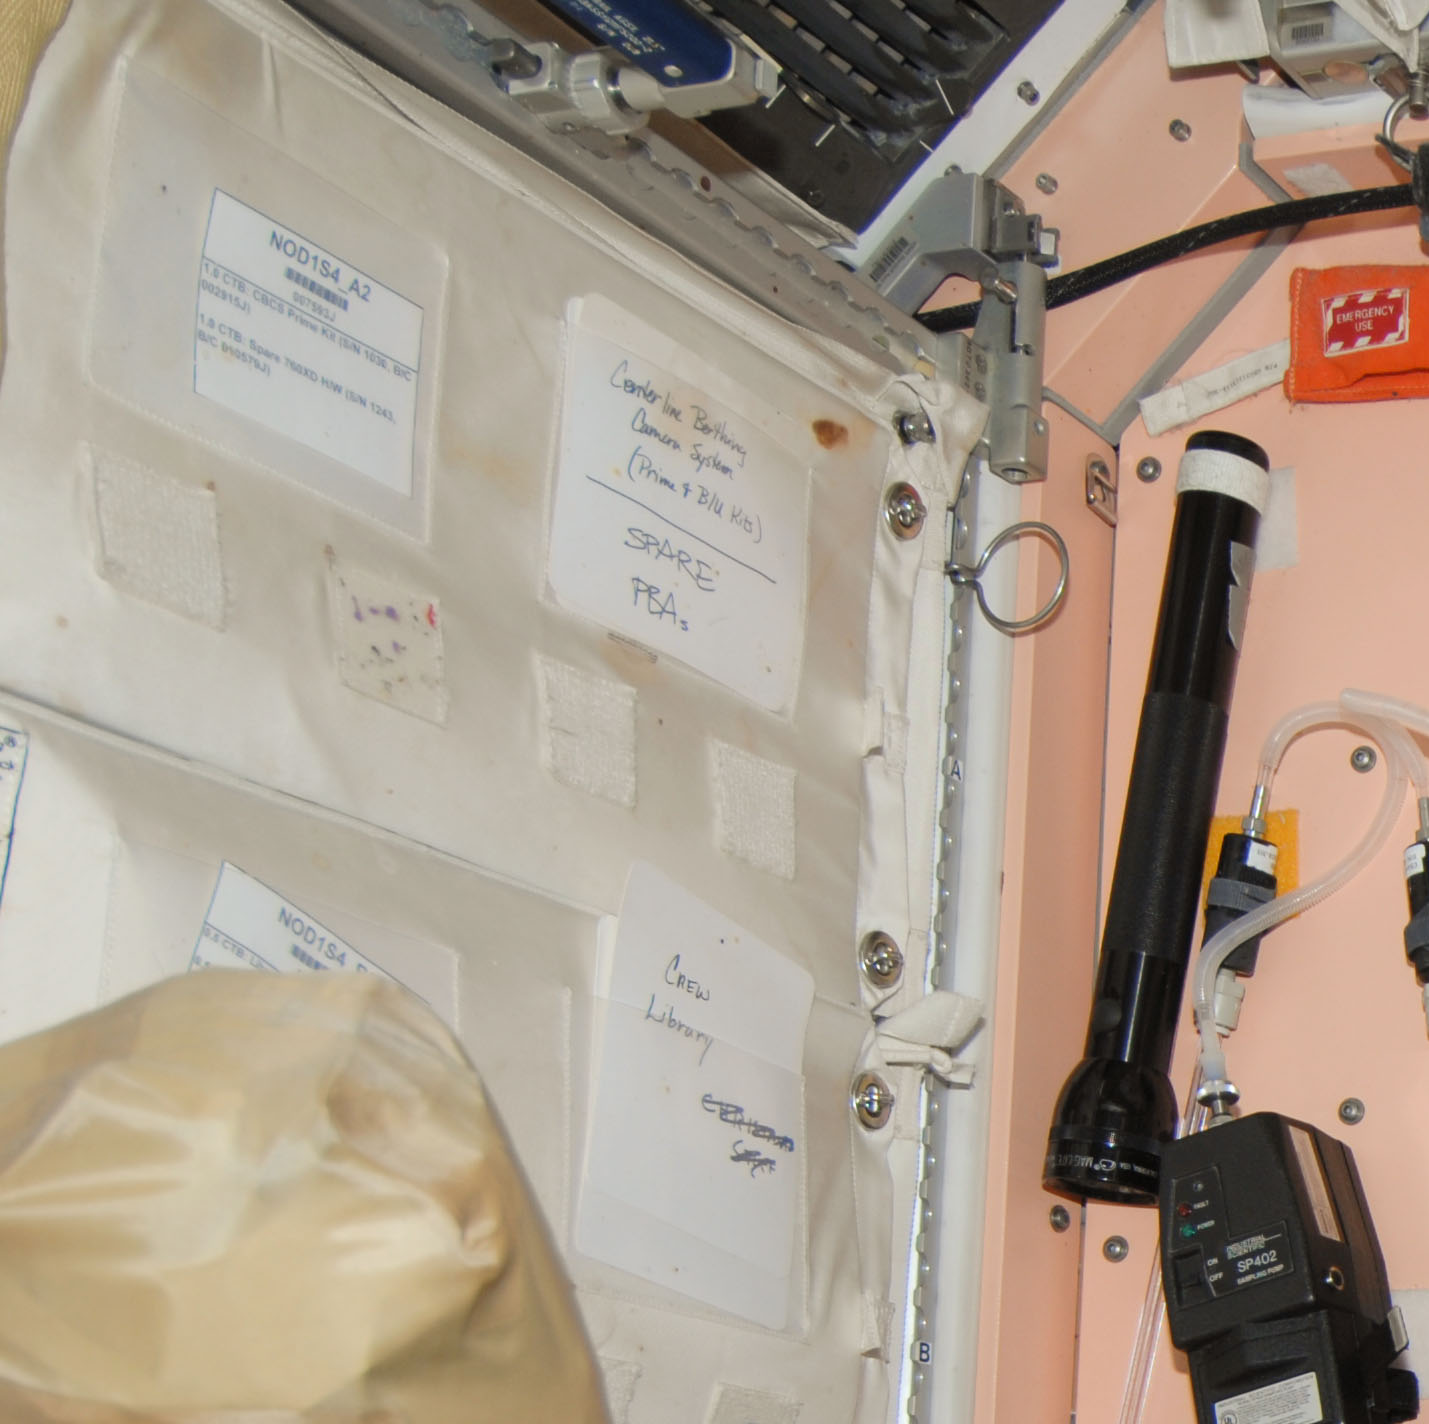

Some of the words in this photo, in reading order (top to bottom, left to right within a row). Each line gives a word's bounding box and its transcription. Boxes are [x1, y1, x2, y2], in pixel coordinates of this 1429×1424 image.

[269, 231, 371, 301] NOD1S4_A2
[1337, 305, 1394, 324] EMERGENCY
[1355, 320, 1373, 332] USE
[632, 407, 681, 453] Camera
[690, 444, 733, 480] System
[691, 405, 746, 467] Berthing
[624, 528, 715, 592] SPARE
[645, 994, 714, 1066] Library
[1208, 1258, 1218, 1266] ON
[1210, 1272, 1223, 1282] OFF
[1237, 1250, 1277, 1272] SP402
